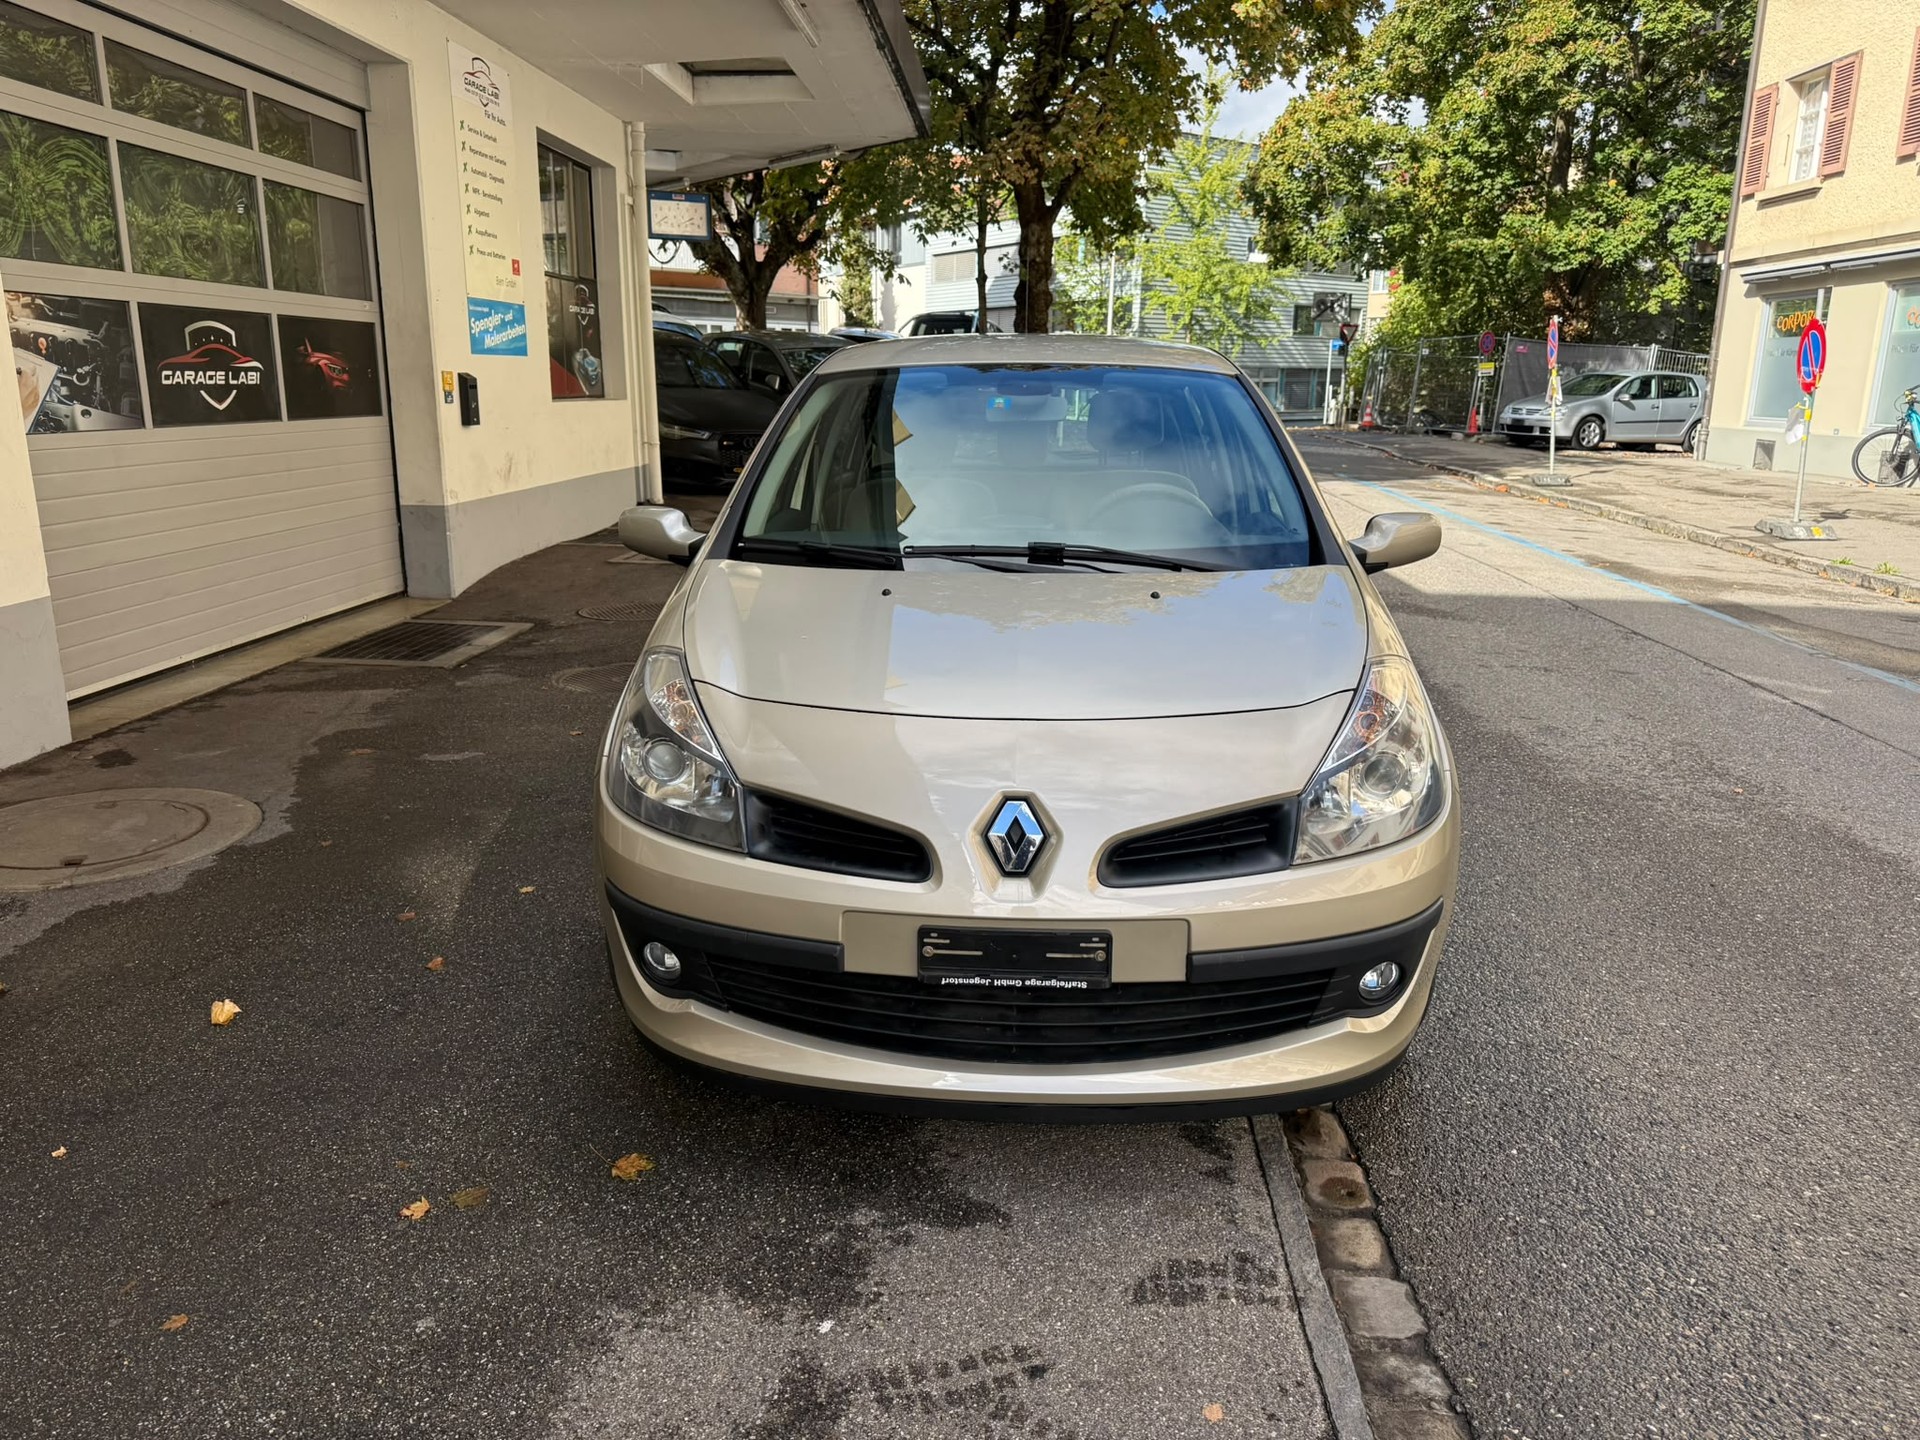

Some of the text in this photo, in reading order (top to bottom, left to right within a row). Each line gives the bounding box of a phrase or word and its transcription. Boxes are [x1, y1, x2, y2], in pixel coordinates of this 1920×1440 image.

[464, 77, 487, 94] GARAGE
[569, 304, 585, 314] GARAGE
[470, 309, 514, 338] Spengler- und
[484, 323, 526, 349] Malerarbeiten
[161, 370, 226, 385] GARAGE
[941, 976, 1088, 989] Staffelgarage GmbH Jegenstorf
